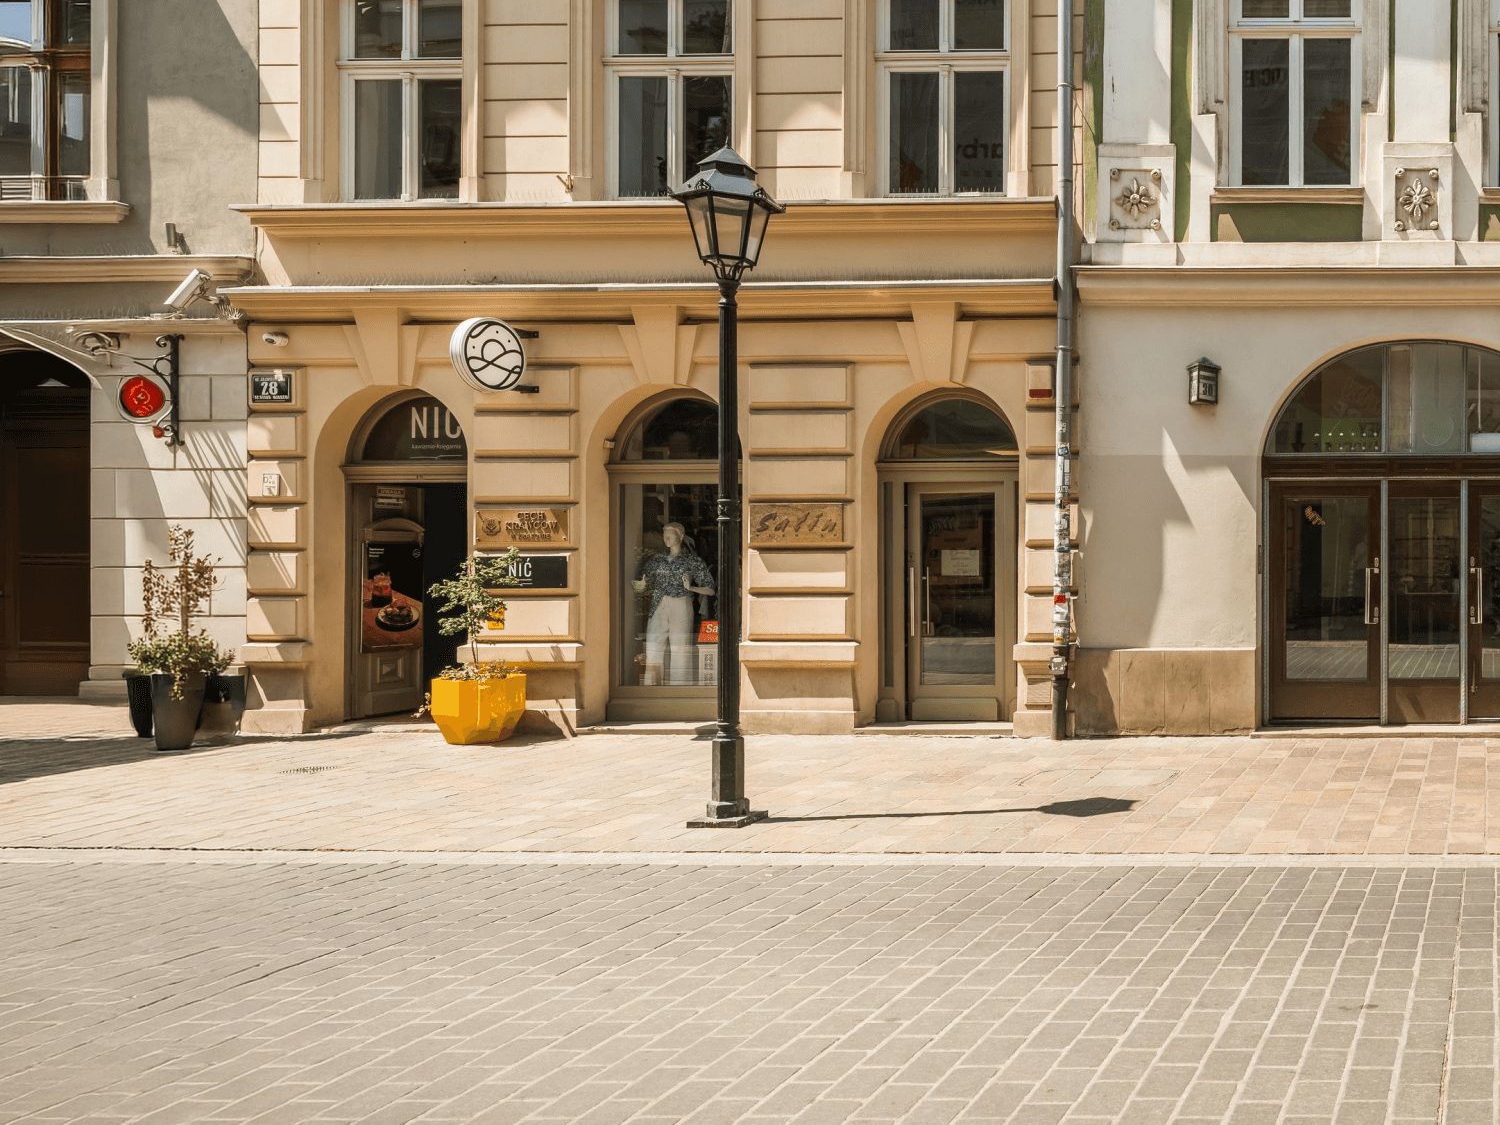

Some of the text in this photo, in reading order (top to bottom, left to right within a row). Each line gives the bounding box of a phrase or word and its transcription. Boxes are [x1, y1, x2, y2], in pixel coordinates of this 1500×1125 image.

[260, 381, 278, 395] 28
[1202, 382, 1213, 396] 30
[517, 511, 545, 521] CECH
